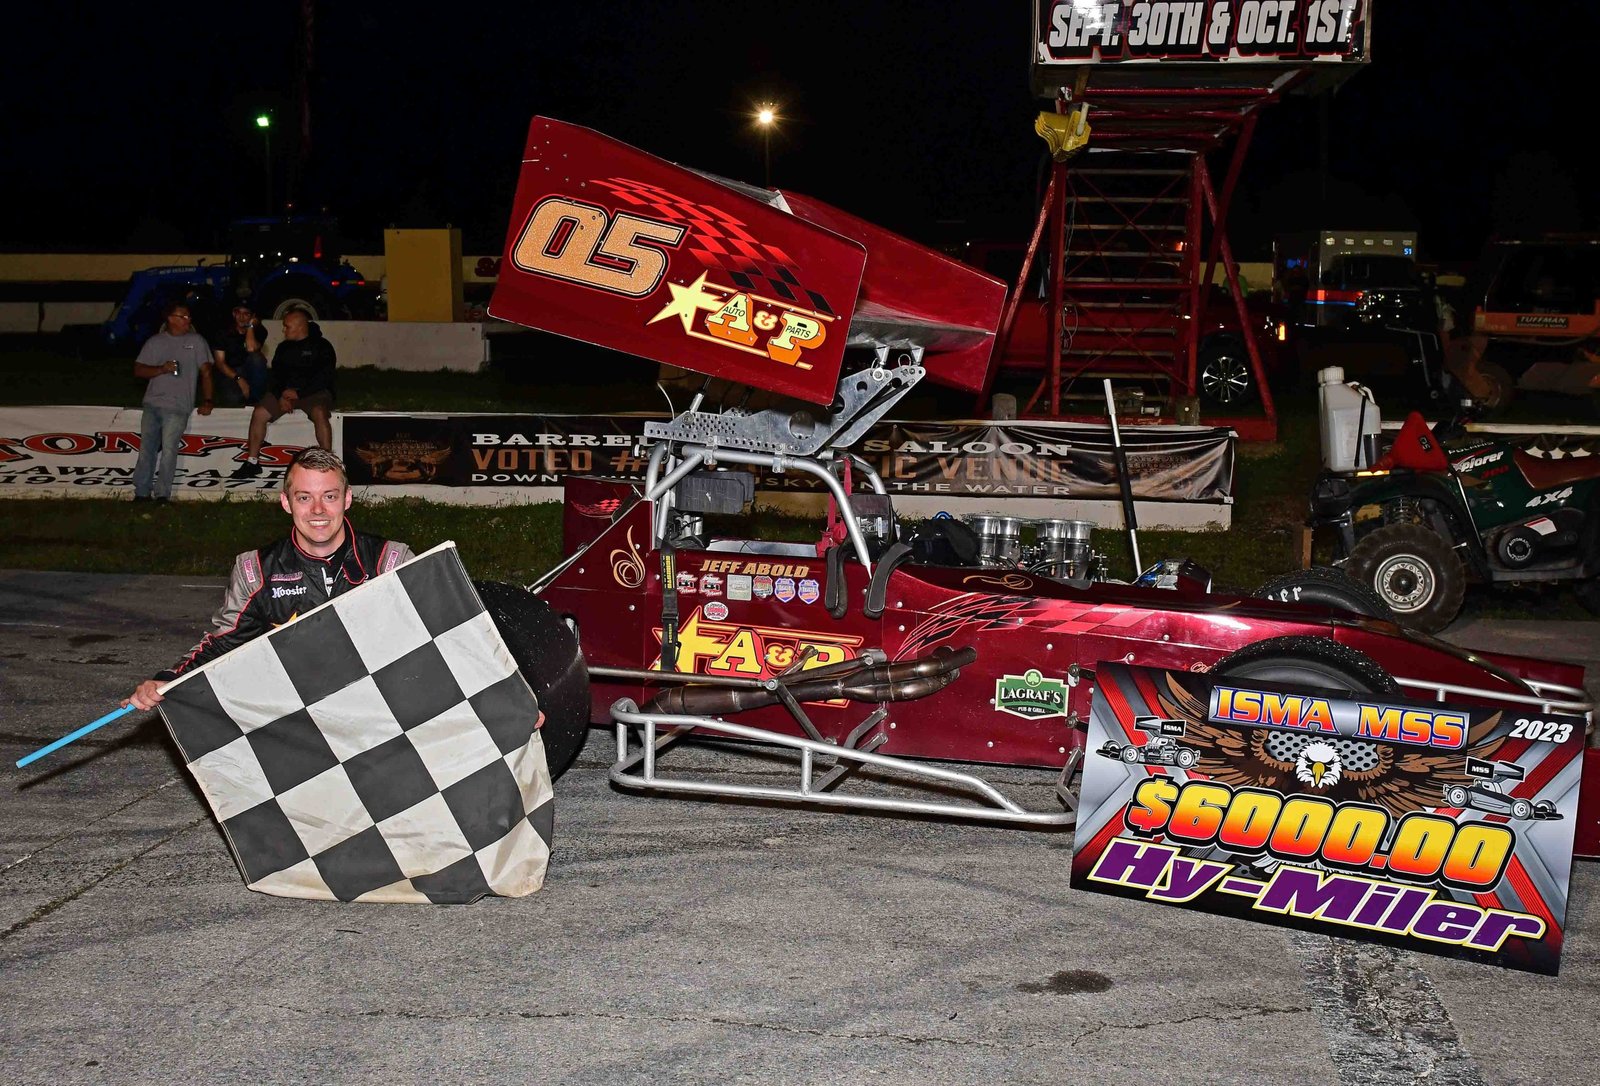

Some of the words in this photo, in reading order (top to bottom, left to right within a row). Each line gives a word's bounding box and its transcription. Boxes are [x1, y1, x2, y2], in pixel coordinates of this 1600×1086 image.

[1050, 1, 1120, 47] SEPT.
[1128, 1, 1204, 45] 30TH
[1208, 1, 1231, 44] &
[1236, 0, 1296, 44] OCT.
[510, 194, 691, 299] 05
[723, 306, 746, 317] AUTO
[786, 325, 812, 338] PARTS
[864, 440, 1073, 457] SALOON
[472, 449, 592, 471] VOTED
[937, 457, 1073, 481] VENUE
[893, 482, 951, 492] THE
[965, 484, 1070, 495] WATER
[700, 560, 742, 574] JEFF
[742, 562, 810, 578] ABOLD
[271, 585, 307, 599] Hoosier
[1001, 687, 1060, 704] LAGRAF'S
[1215, 685, 1342, 735] ISMA
[1353, 703, 1468, 750] MSS
[1163, 724, 1183, 732] ISMA
[1509, 719, 1573, 744] 2023
[1471, 765, 1490, 774] MSS
[1126, 775, 1513, 889] $6000.00
[1087, 837, 1547, 953] Hy-Miler
